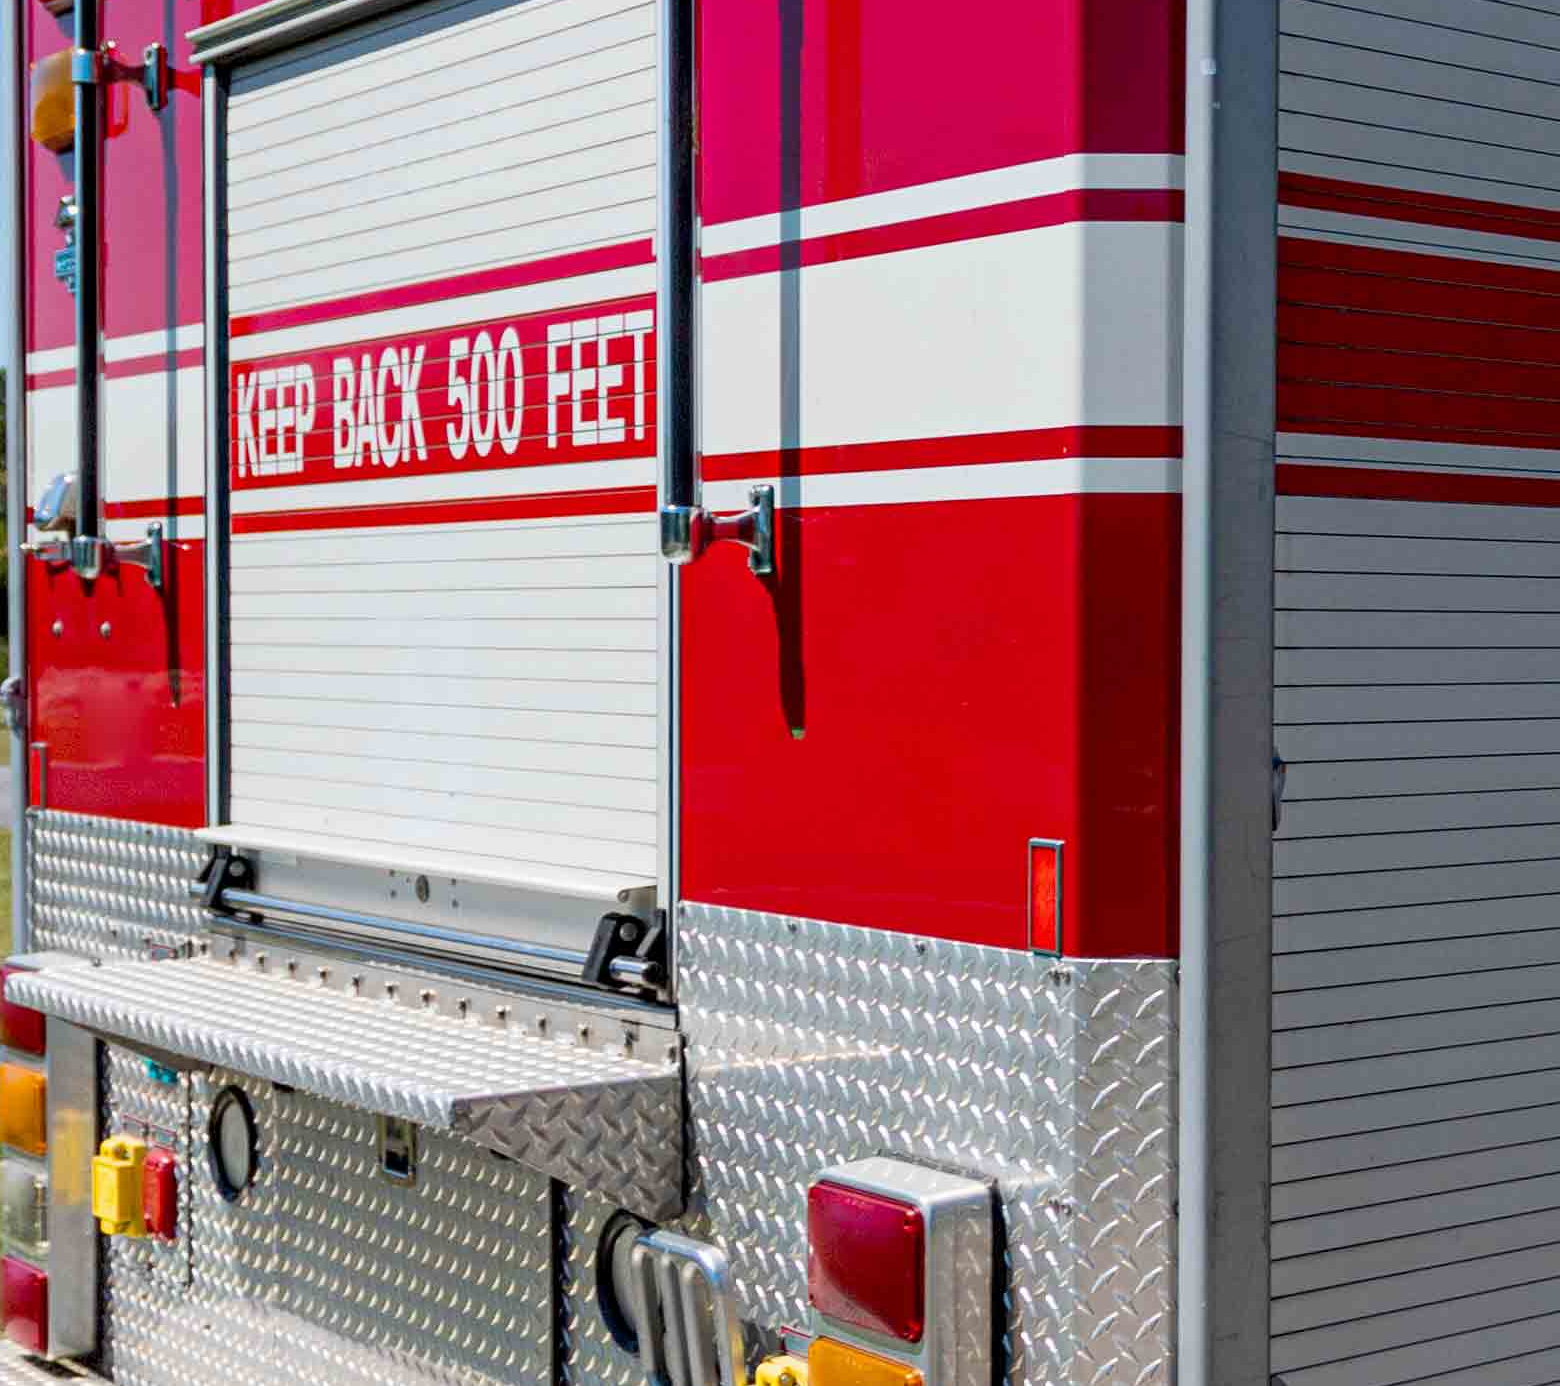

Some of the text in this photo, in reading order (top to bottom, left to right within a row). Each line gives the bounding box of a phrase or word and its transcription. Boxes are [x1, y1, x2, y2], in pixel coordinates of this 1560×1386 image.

[236, 309, 654, 478] KEEP BACK 500 FEET
